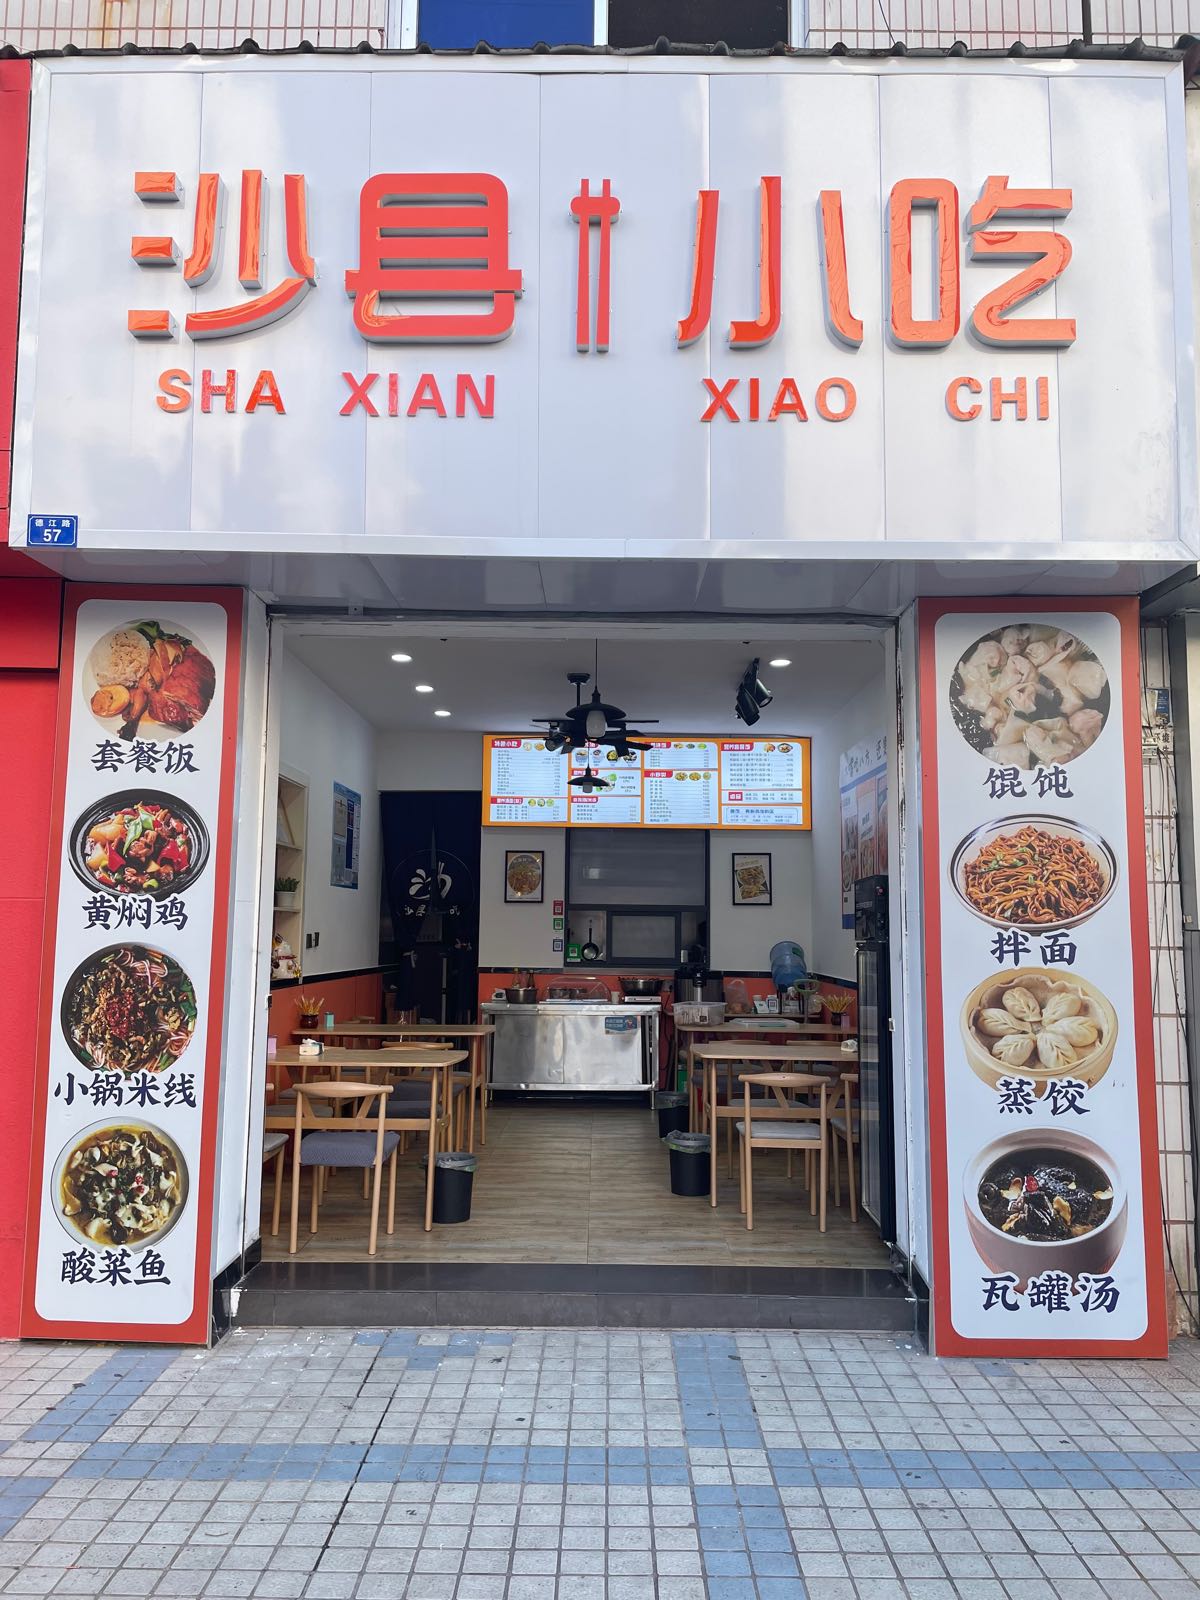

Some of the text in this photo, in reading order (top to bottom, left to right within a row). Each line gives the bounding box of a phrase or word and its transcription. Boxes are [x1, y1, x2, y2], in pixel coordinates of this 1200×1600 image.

[156, 368, 1050, 423] SHA XIAN XIAO CHI
[43, 528, 62, 542] 57
[90, 739, 200, 774] 套餐饭
[982, 766, 1074, 800] 馄饨
[81, 895, 189, 931] 黄焖鸡
[990, 930, 1077, 967] 拌面
[54, 1072, 197, 1109] 小锅米线
[997, 1078, 1091, 1116] 蒸饺
[60, 1246, 172, 1287] 酸菜鱼
[980, 1273, 1121, 1315] 瓦罐汤
